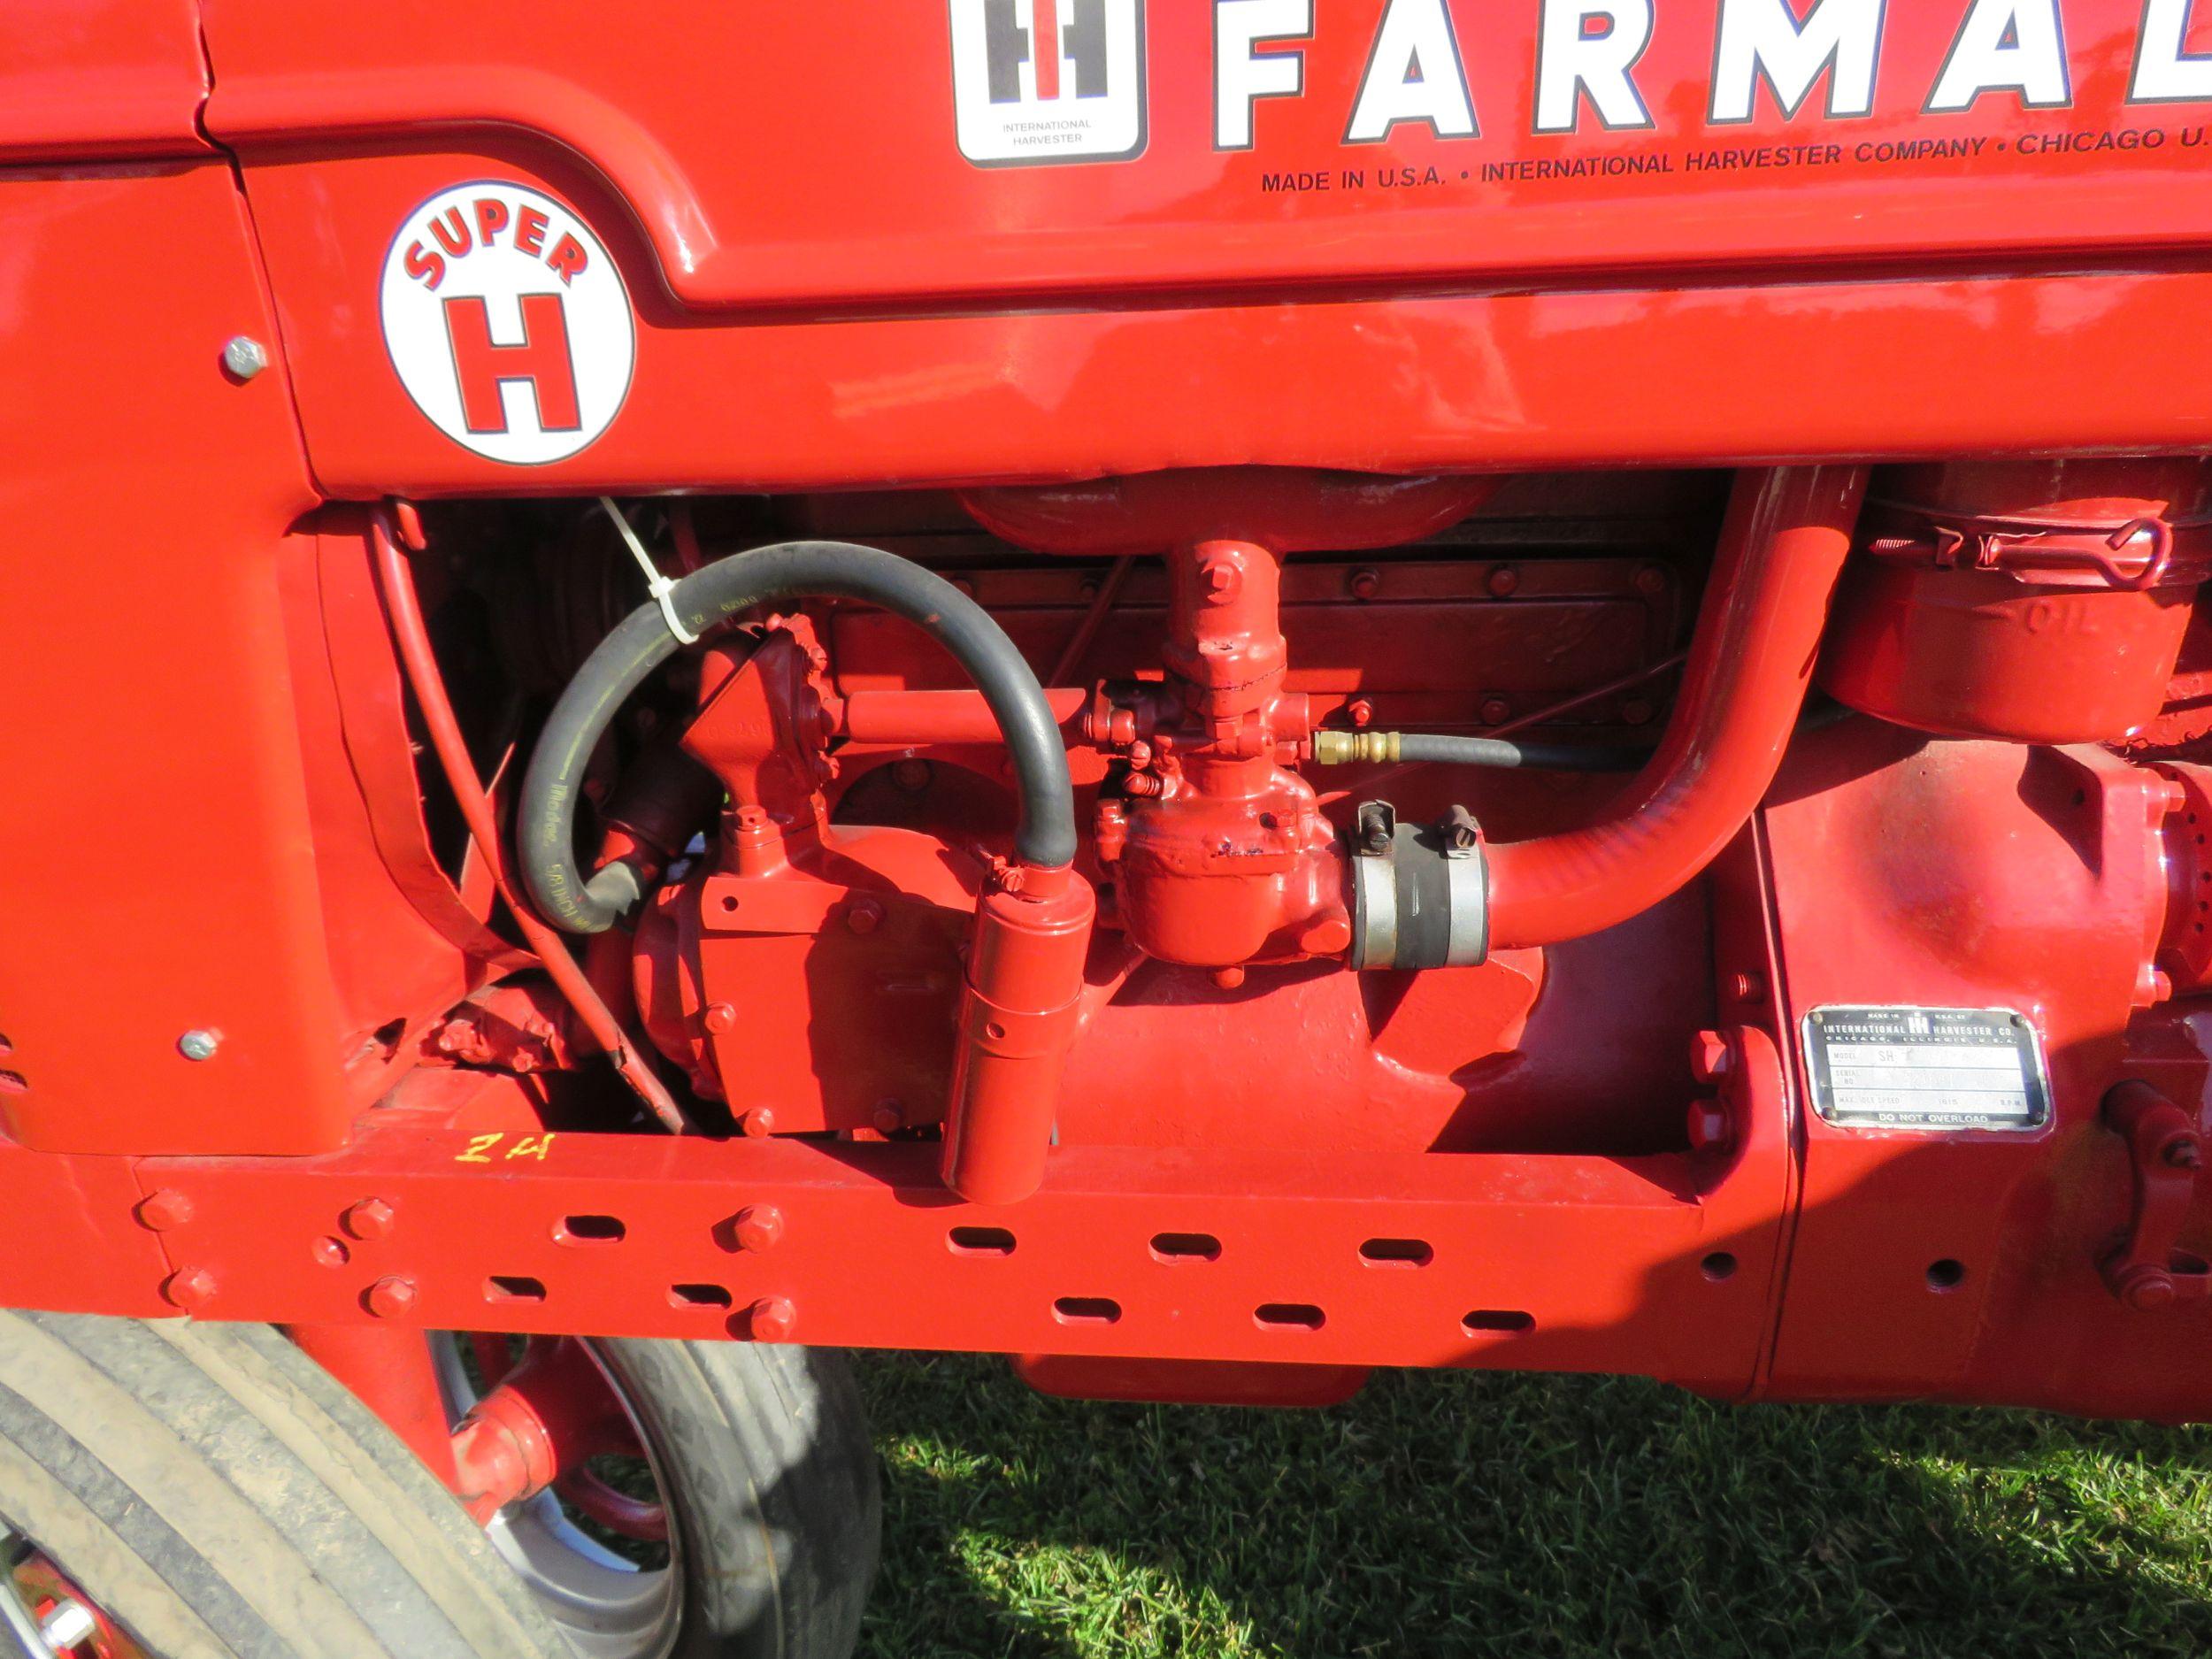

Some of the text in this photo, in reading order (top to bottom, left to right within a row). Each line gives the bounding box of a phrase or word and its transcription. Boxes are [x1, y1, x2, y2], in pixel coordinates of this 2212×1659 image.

[1002, 119, 1092, 133] INTERNATIONAL
[1013, 134, 1083, 146] HARVESTER
[1262, 172, 1330, 192] MADE
[1341, 171, 1364, 188] IN
[1378, 165, 1447, 189] U.S.A.
[1481, 152, 1674, 182] INTERNATIONAL
[1685, 142, 1842, 172] HARVESTER
[1854, 136, 1987, 163] COMPANY
[2016, 128, 2165, 155] CHICAGO
[403, 198, 589, 292] SUPER
[442, 293, 584, 434] H
[1824, 1025, 1906, 1034] INTERNATIONAL
[1933, 1026, 1993, 1036] HARVESTER
[1998, 1027, 2015, 1036] CO.
[1928, 1114, 1988, 1124] OVERLOAD
